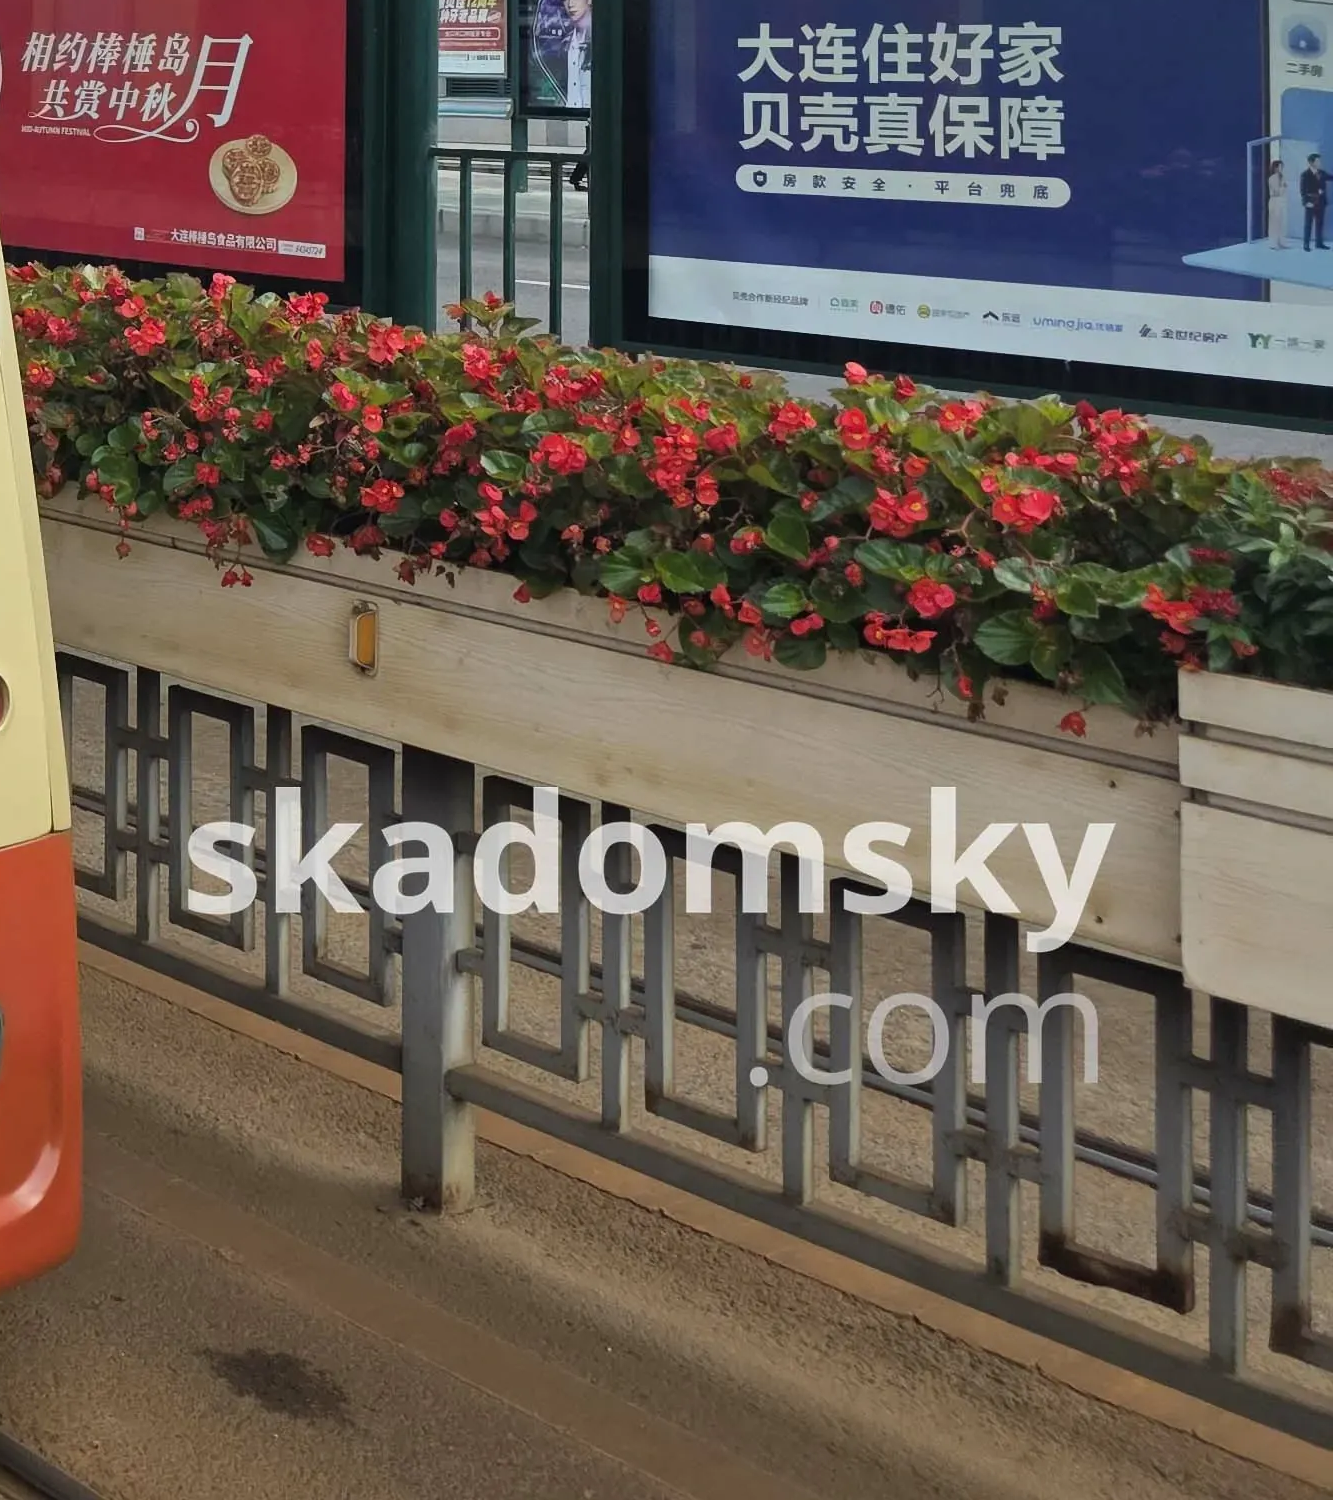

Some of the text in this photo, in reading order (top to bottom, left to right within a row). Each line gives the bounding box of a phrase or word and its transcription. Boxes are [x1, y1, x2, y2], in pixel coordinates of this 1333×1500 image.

[737, 21, 1065, 87] 大连住好家
[1285, 62, 1323, 78] 二手房
[738, 91, 1065, 161] 贝壳真保障
